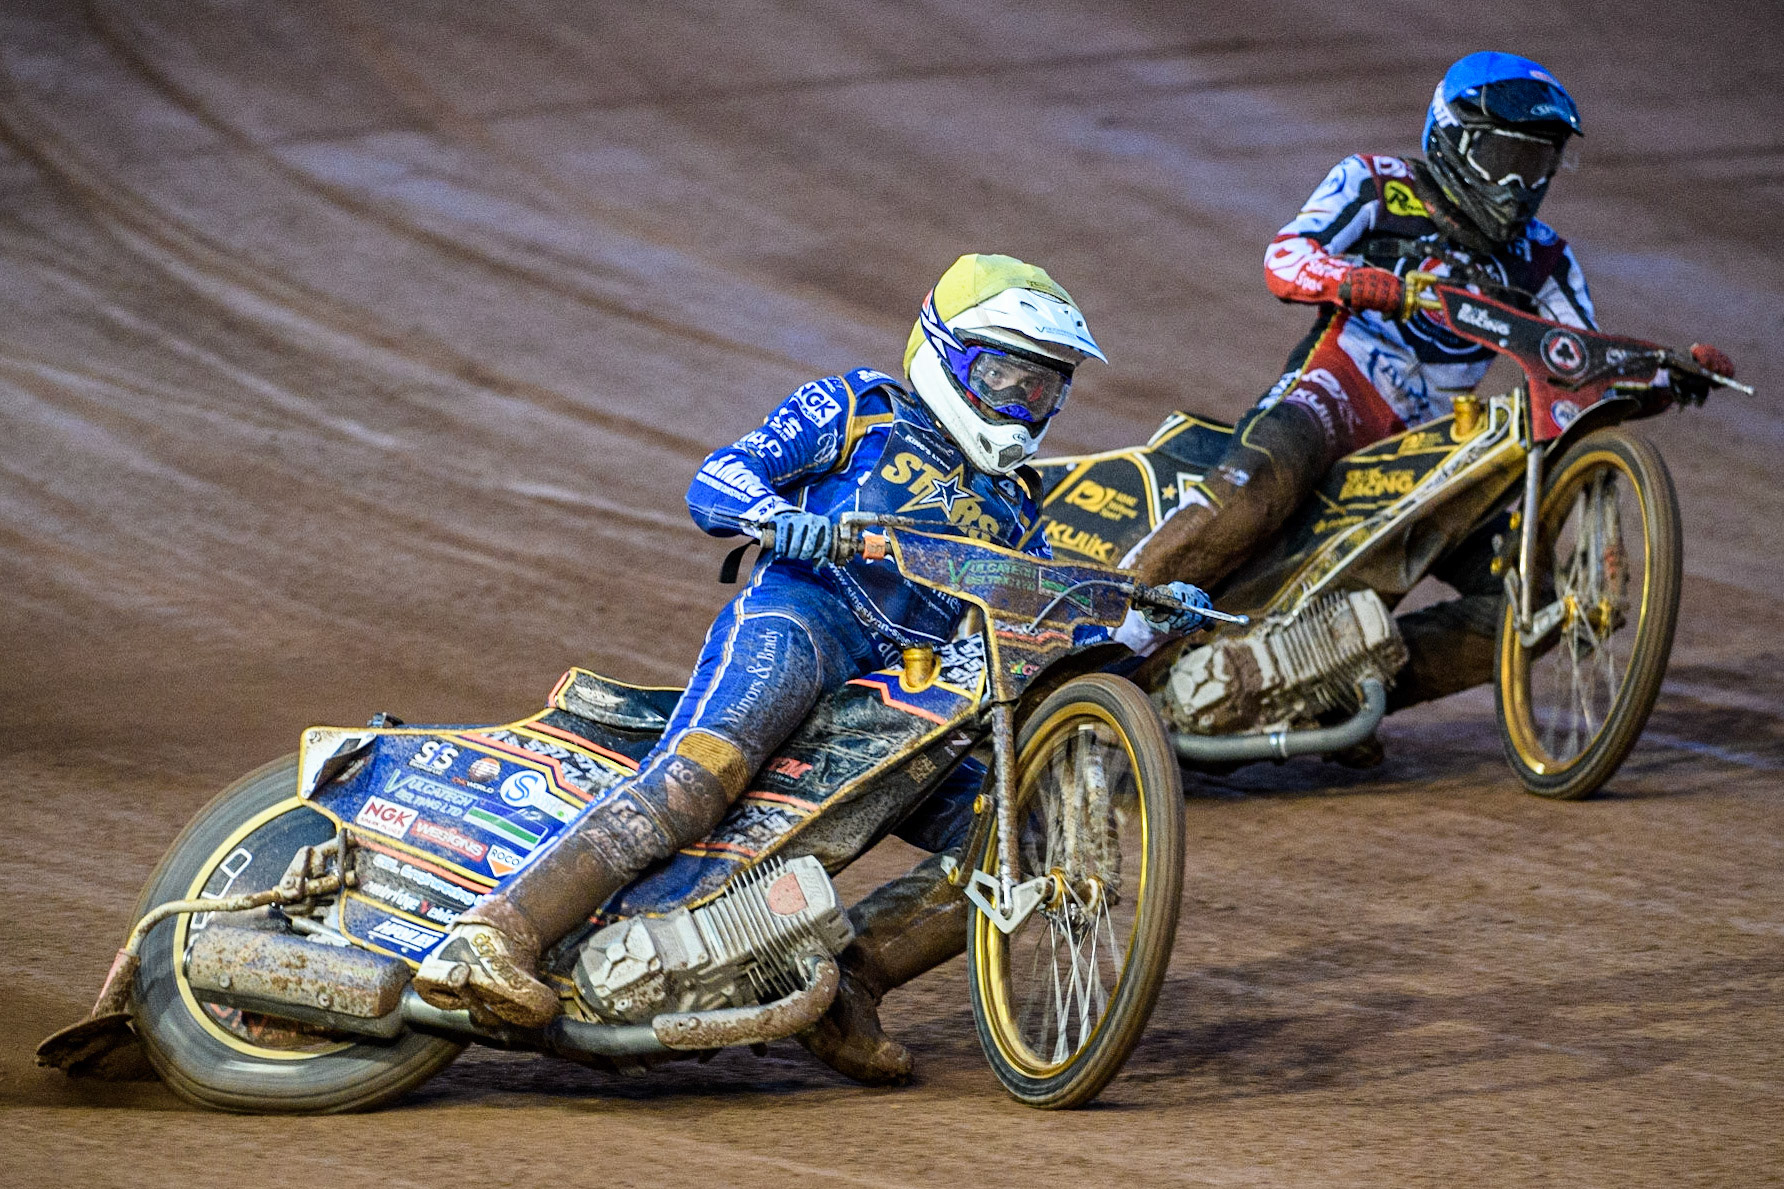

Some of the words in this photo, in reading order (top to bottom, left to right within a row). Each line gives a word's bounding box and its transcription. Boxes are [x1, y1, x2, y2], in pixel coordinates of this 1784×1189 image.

[757, 628, 783, 662] Brady
[746, 665, 773, 680] &
[722, 679, 766, 727] Minors
[363, 801, 412, 828] NGK
[491, 848, 520, 867] ROCO
